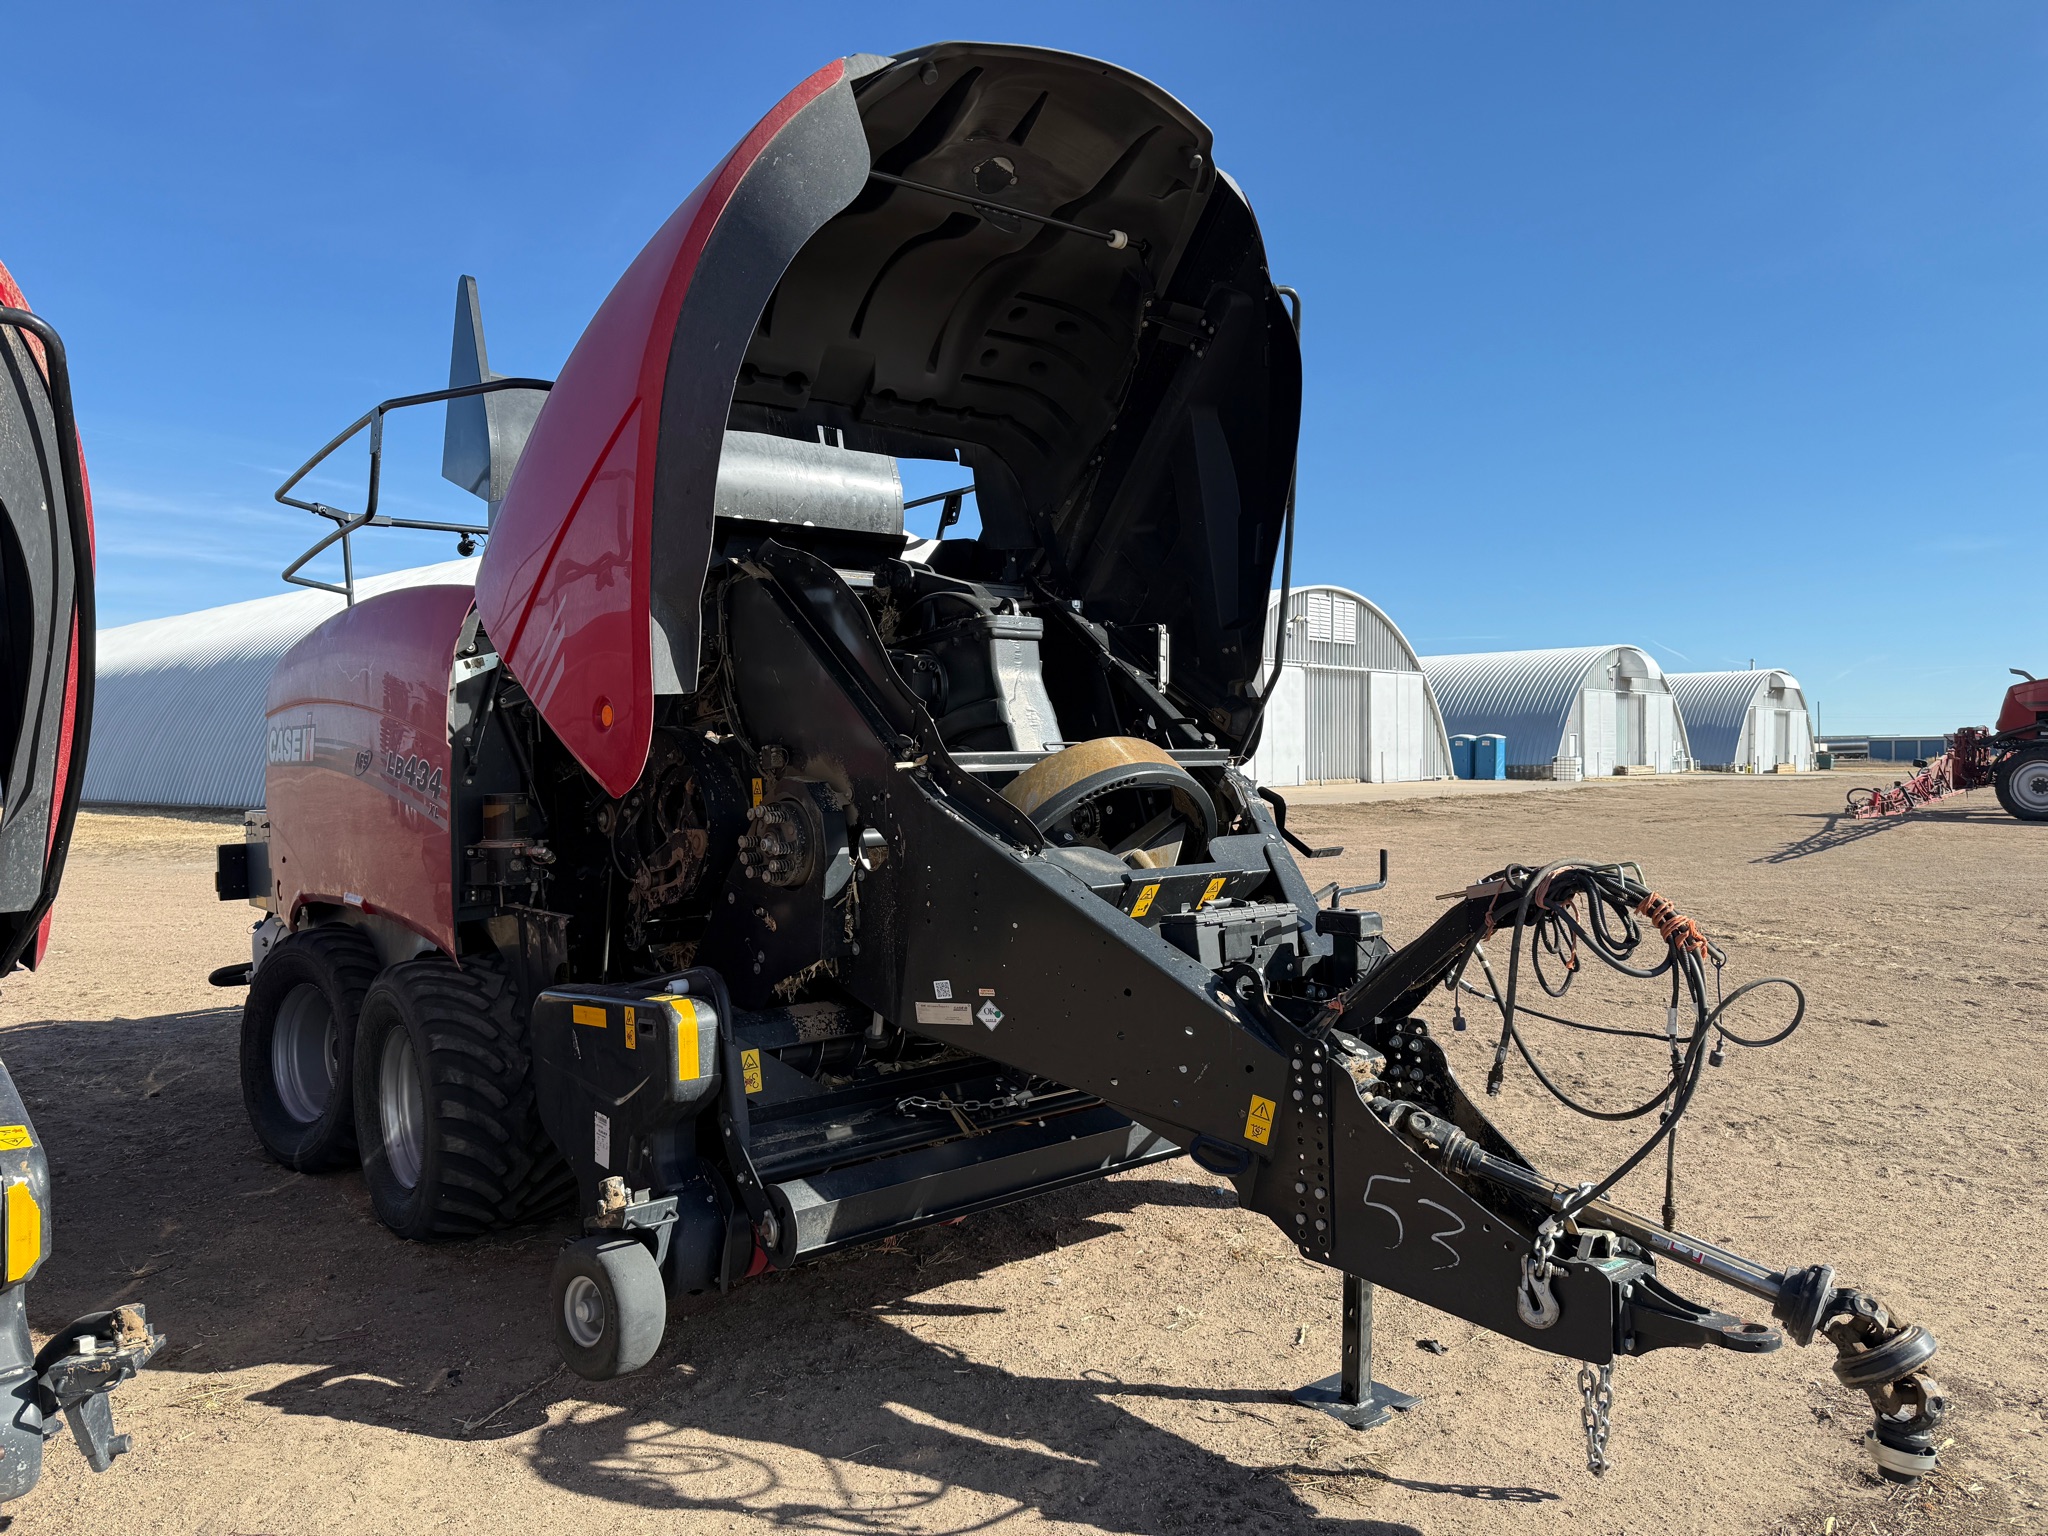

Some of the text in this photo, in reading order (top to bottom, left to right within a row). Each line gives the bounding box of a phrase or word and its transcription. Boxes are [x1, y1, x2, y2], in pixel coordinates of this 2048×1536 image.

[386, 750, 443, 800] LB434
[428, 802, 439, 819] XL
[1363, 1174, 1466, 1271] 53
